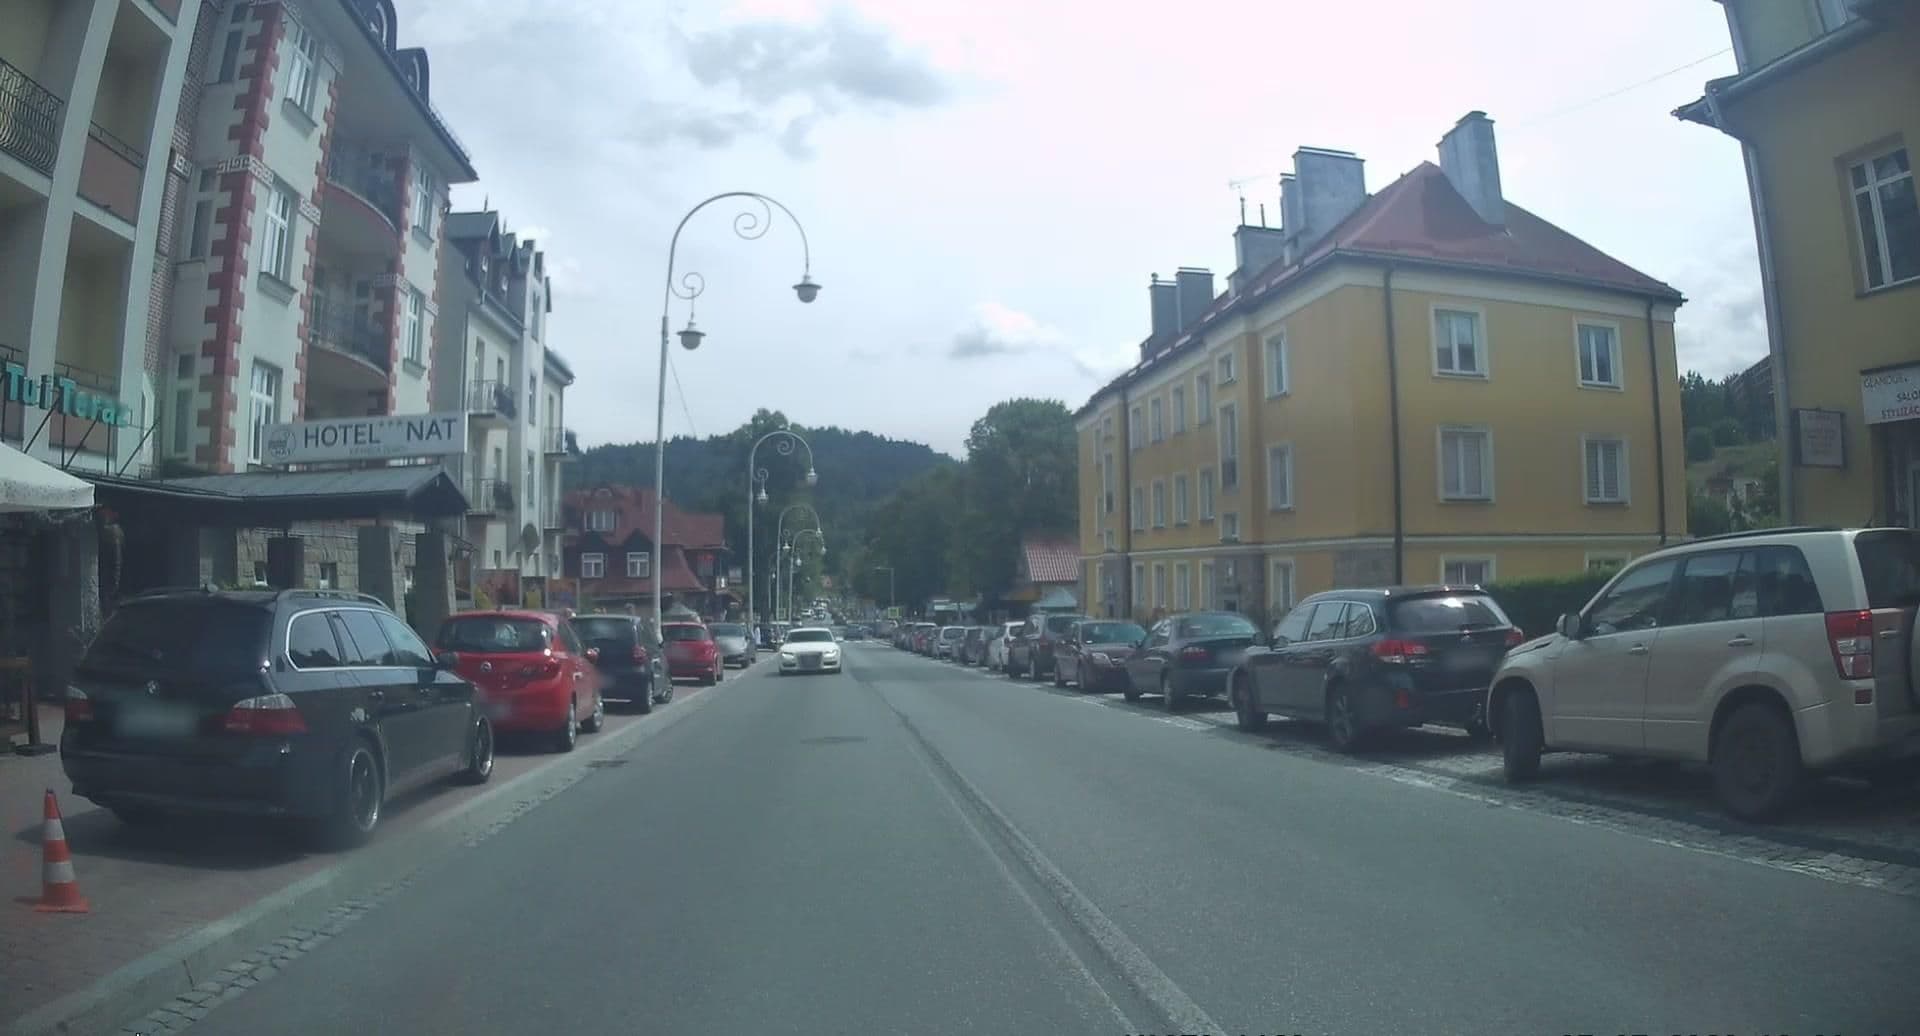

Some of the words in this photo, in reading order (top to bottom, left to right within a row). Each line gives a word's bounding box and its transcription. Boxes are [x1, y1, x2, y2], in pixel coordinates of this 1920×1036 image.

[1896, 389, 1920, 402] SALO
[304, 422, 381, 449] HOTEL
[406, 418, 457, 442] NAT
